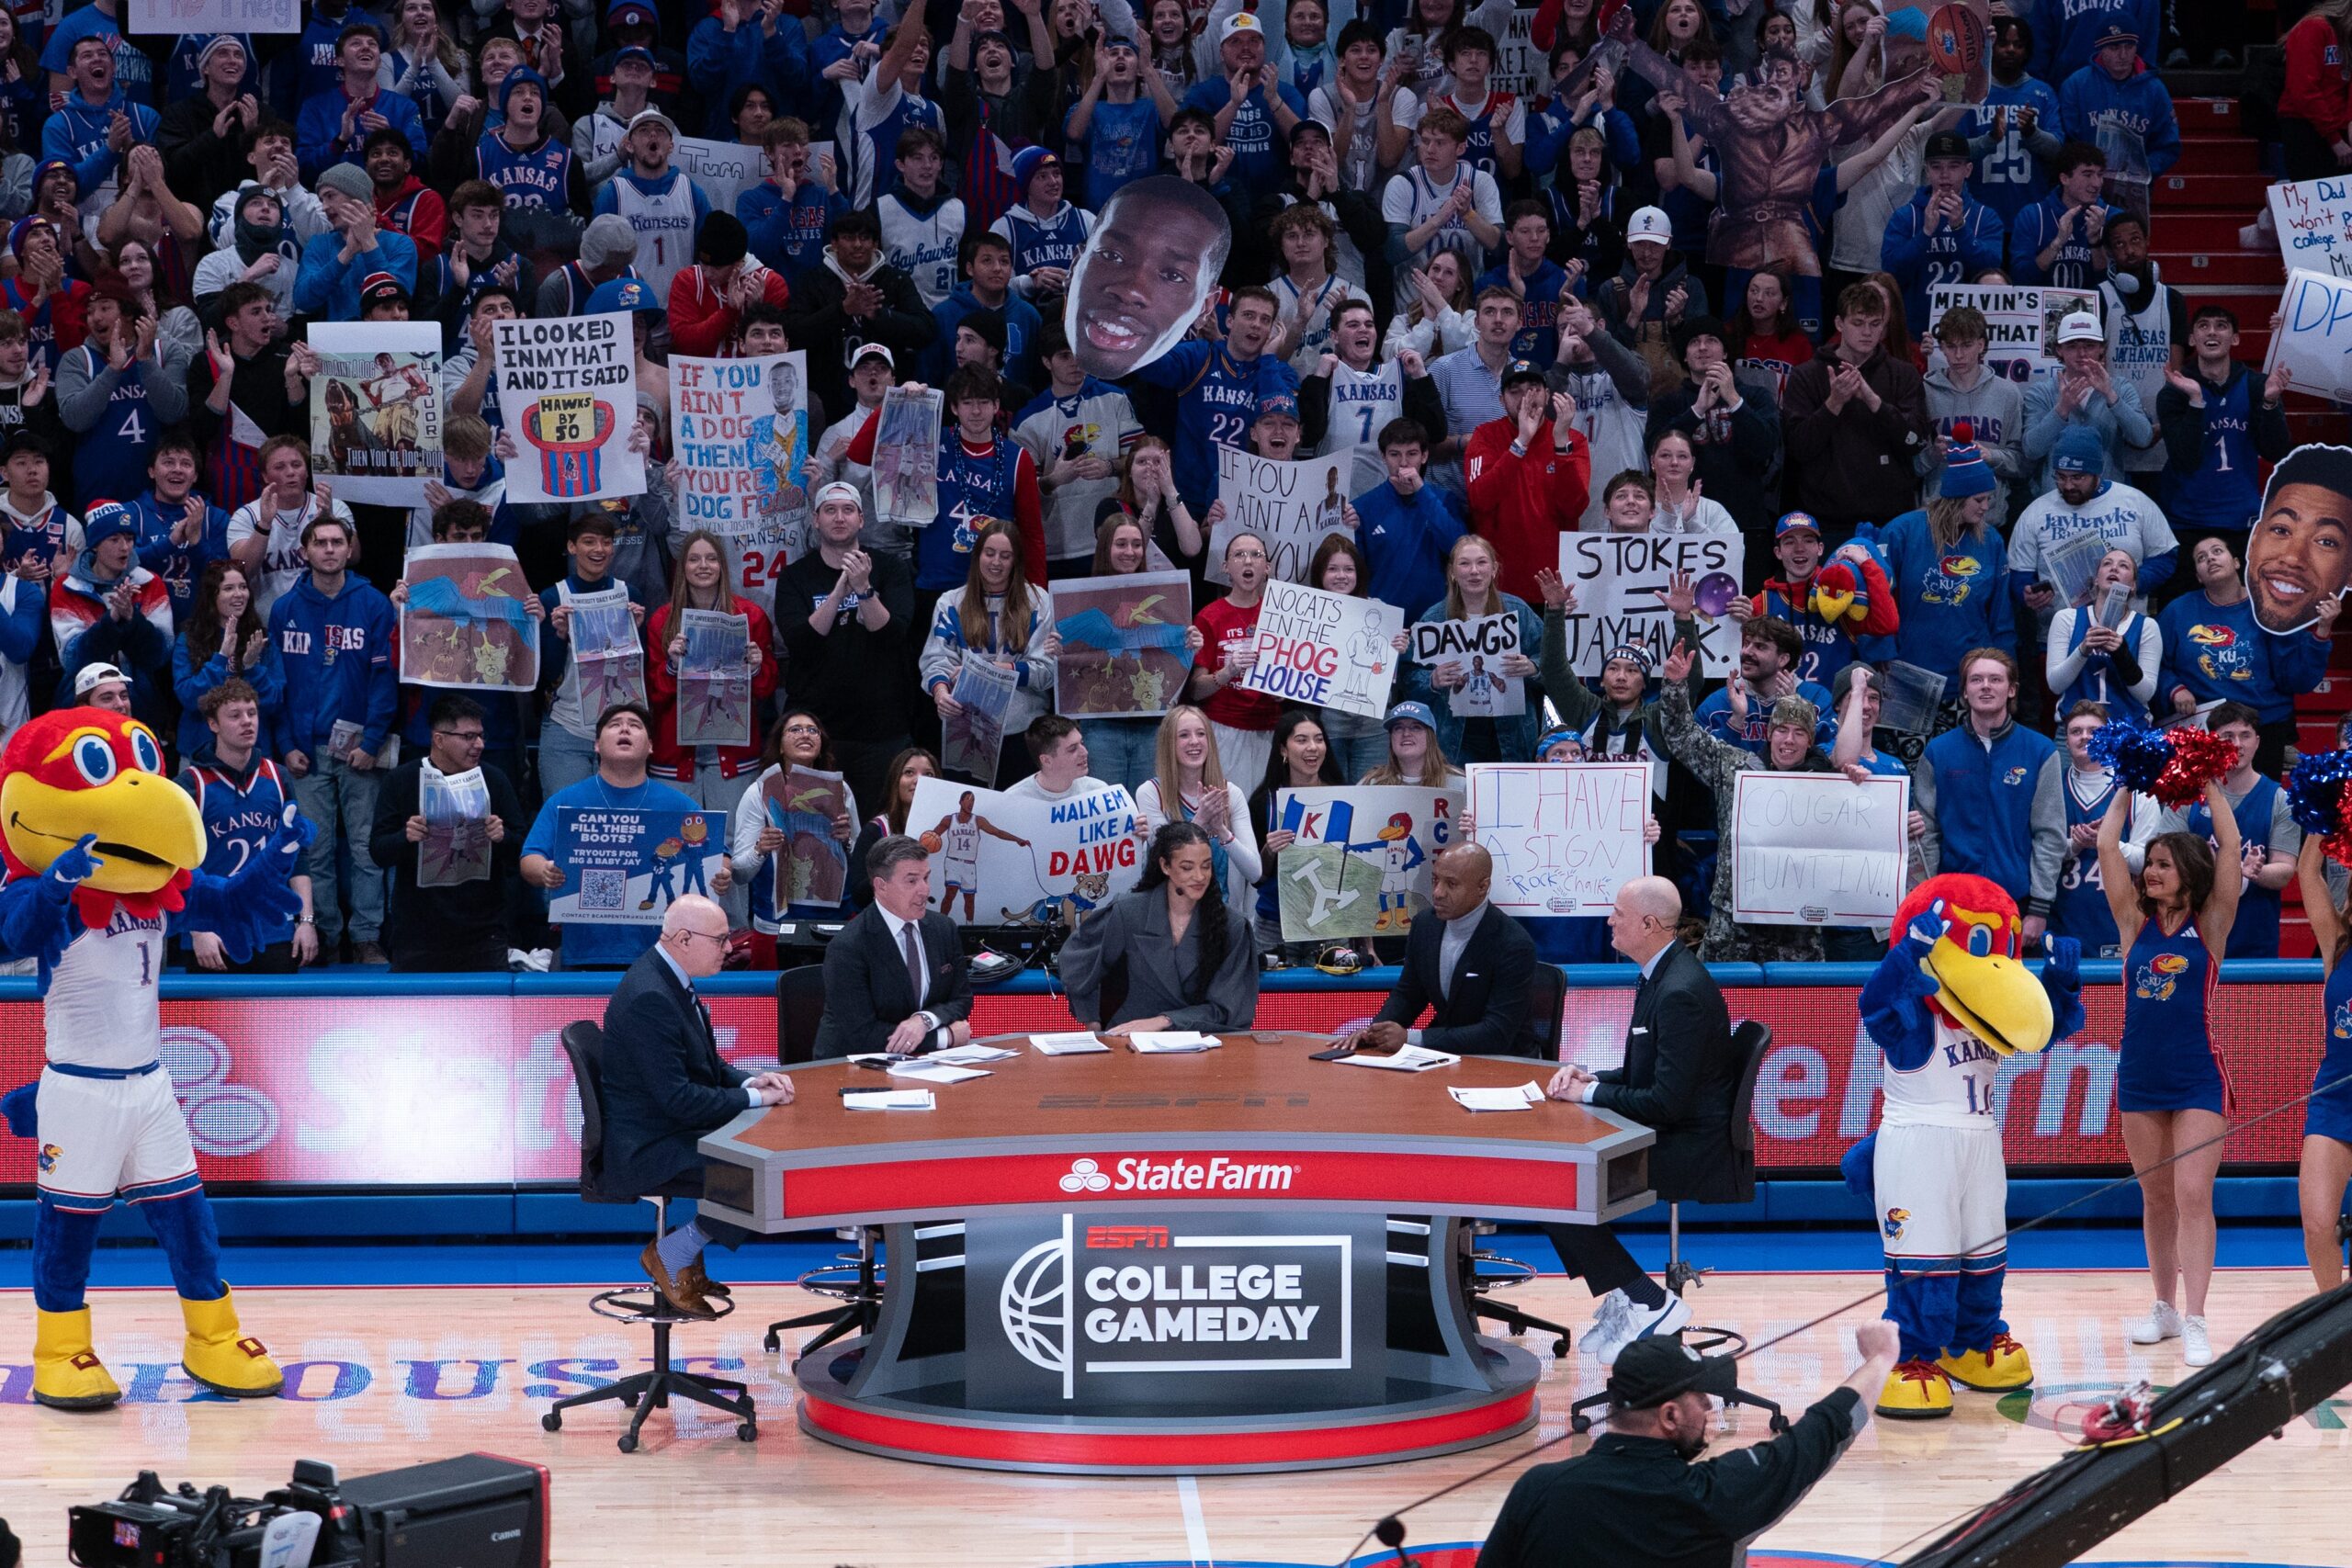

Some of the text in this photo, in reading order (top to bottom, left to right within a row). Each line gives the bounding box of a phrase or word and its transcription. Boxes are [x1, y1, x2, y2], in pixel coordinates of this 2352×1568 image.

[1982, 130, 2033, 184] 25
[489, 167, 558, 192] KANSAS
[1354, 157, 1367, 191] 1
[2318, 181, 2346, 203] Dad
[653, 236, 665, 266] 1
[889, 236, 958, 275] Jayhawks
[1021, 243, 1074, 268] KANSA
[1935, 292, 2039, 310] MELVIN'S
[499, 320, 615, 346] I LOOKED
[2112, 347, 2169, 364] JAYHAWKS
[506, 371, 548, 389] AND
[581, 365, 629, 387] SAID
[678, 362, 761, 389] IF YOU
[2131, 369, 2146, 381] KU
[540, 396, 593, 413] HAWKS
[1336, 382, 1398, 403] KANSAS
[118, 408, 146, 445] 4
[559, 412, 577, 425] BY
[681, 415, 753, 440] A DOG
[1207, 412, 1246, 446] 22
[1356, 406, 1376, 445] 7
[2206, 419, 2249, 434] ANSAS
[555, 424, 580, 442] 50
[345, 447, 368, 468] THEN
[370, 447, 401, 468] YOU'RE
[683, 444, 745, 468] THEN
[2215, 434, 2233, 472] 1
[1219, 446, 1297, 498] IF YOU
[686, 493, 733, 519] DOG
[1294, 502, 1311, 535] A
[2039, 507, 2137, 533] Jayhawks
[742, 549, 787, 588] 24
[1577, 536, 1726, 581] STOKES
[1939, 578, 1955, 592] KU
[1416, 614, 1519, 660] DAWGS
[1256, 632, 1339, 678] PHOG
[2218, 649, 2238, 664] KU
[1246, 660, 1331, 705] HOUSE
[2093, 666, 2113, 705] 1
[1051, 795, 1101, 824] WALK
[1534, 767, 1643, 832] HAVE
[1744, 788, 1876, 829] COUGAR
[570, 823, 646, 835] FILL THESE
[578, 813, 640, 825] CAN YOU
[1079, 813, 1136, 844] LIKE A
[580, 833, 635, 844] BOOTS?
[956, 837, 971, 852] 14
[568, 857, 585, 865] BIG
[594, 858, 622, 866] BABY
[623, 859, 642, 867] JAY
[572, 849, 639, 859] TRYOUTS FOR
[1049, 838, 1136, 876] DAWG
[1391, 853, 1397, 865] 1
[1484, 833, 1625, 873] A SIGN
[136, 942, 153, 987] 1
[1085, 1225, 1170, 1249] ESPN
[1084, 1265, 1303, 1302] COLLEGE
[1084, 1305, 1320, 1343] GAMEDAY
[491, 1528, 522, 1543] Canon
